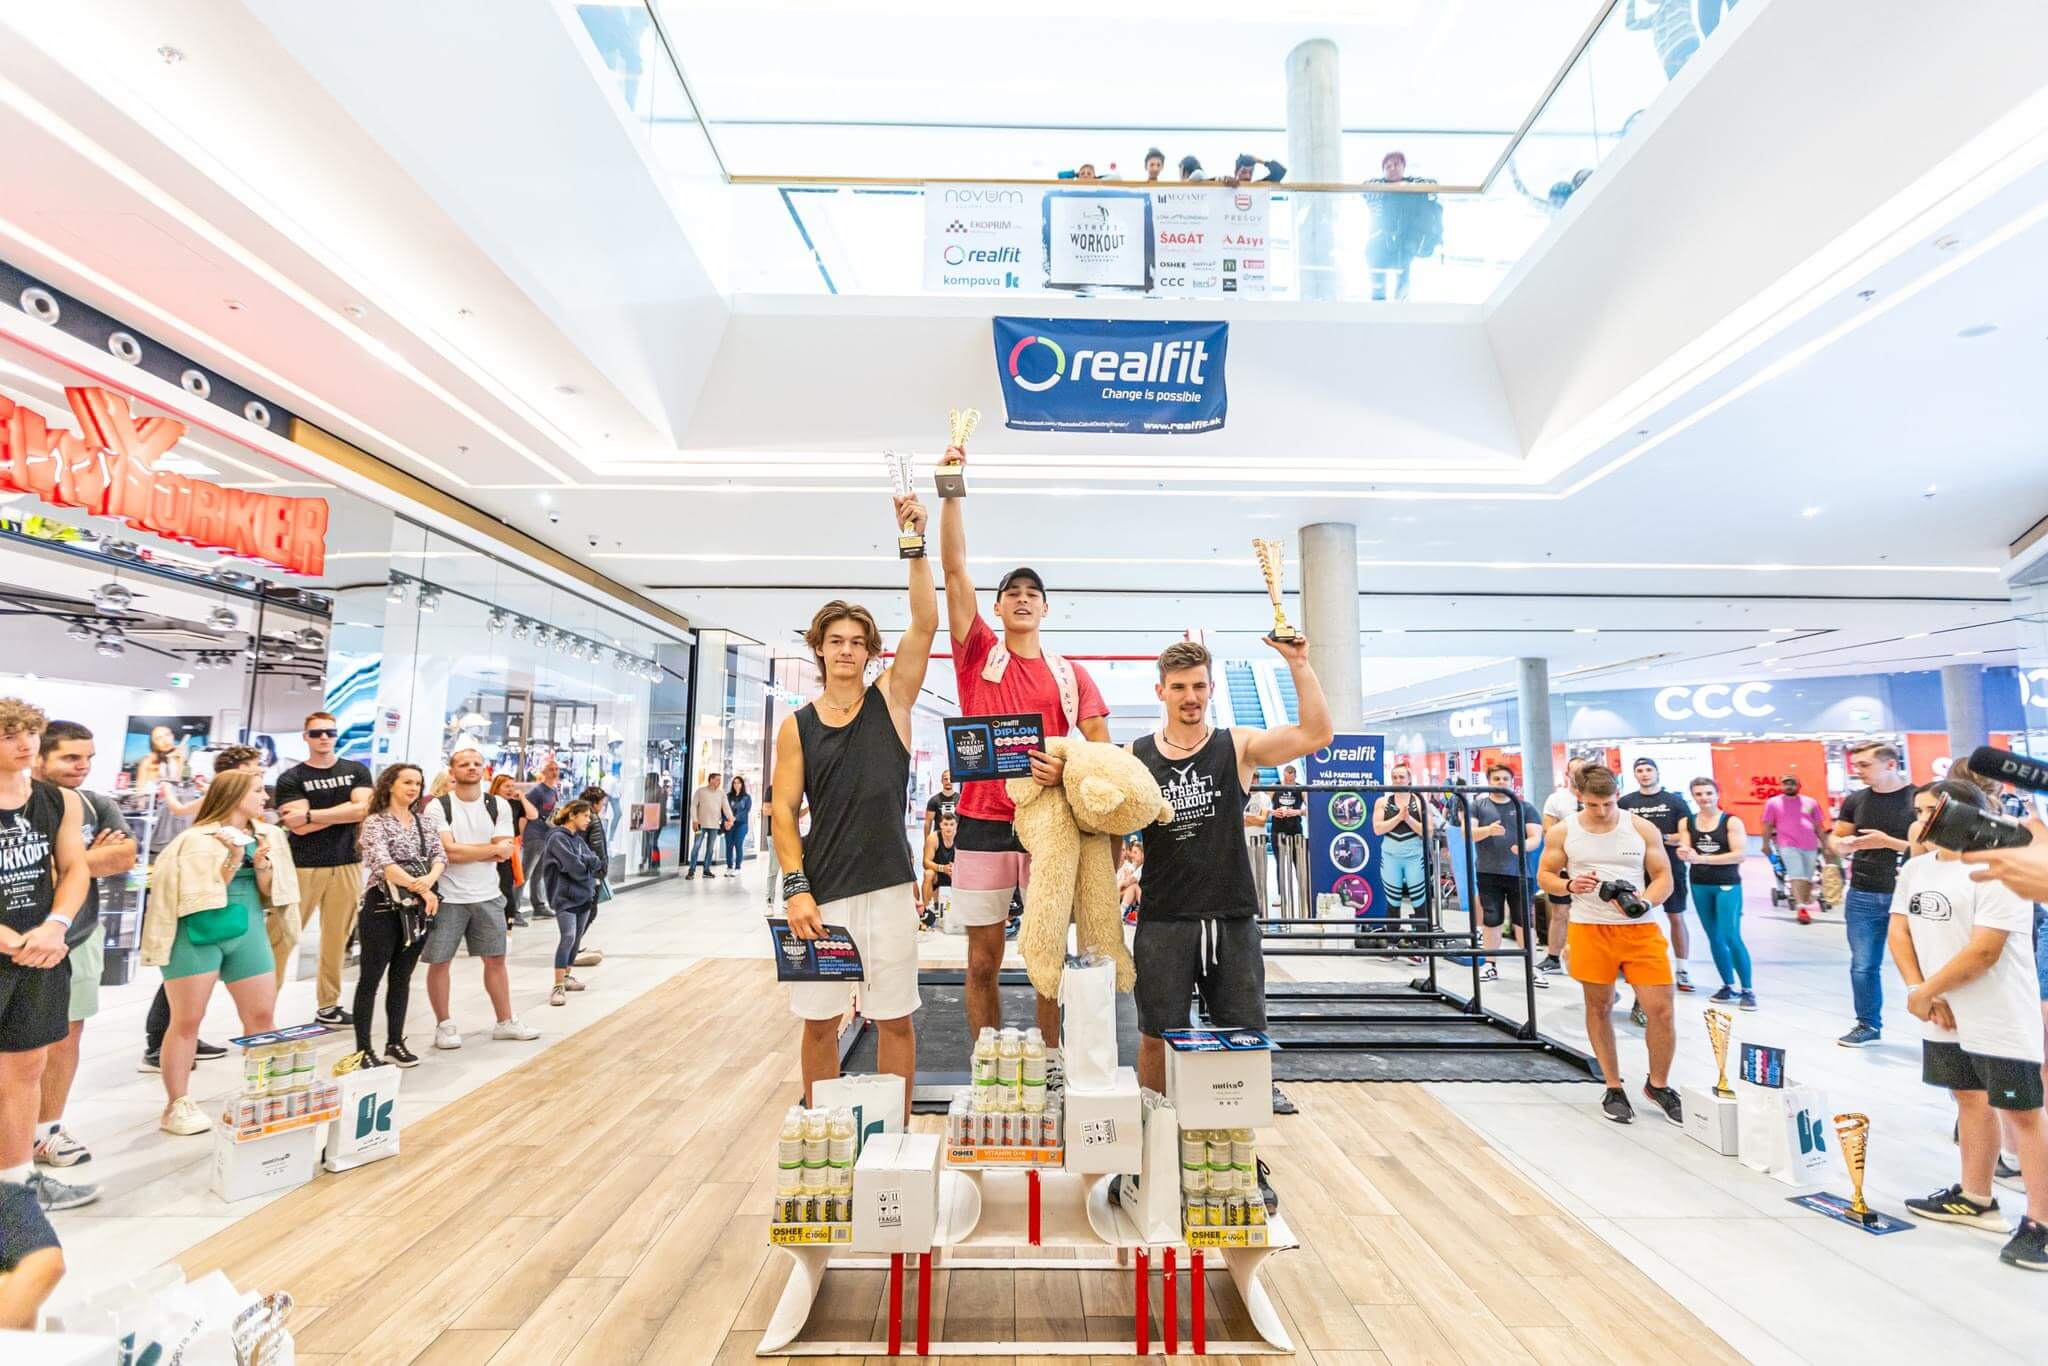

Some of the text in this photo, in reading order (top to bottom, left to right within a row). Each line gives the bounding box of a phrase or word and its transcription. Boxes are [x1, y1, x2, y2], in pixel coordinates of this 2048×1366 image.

[1070, 233, 1126, 252] WORKOUT
[968, 246, 1022, 263] realfit
[944, 275, 1001, 287] kompava
[1160, 278, 1185, 286] CCC
[1070, 341, 1209, 385] realfit
[1102, 387, 1201, 403] Change is possible
[1653, 681, 1776, 720] CCC
[993, 726, 1038, 736] DIPLOM
[1332, 745, 1376, 761] realfit
[2002, 759, 2048, 784] DEIT
[1752, 777, 1780, 785] SAL
[1163, 781, 1206, 800] STREET
[1170, 791, 1213, 811] ORKOUT
[0, 842, 50, 870] RKOUT
[773, 1227, 803, 1236] OSHEE
[1191, 1231, 1220, 1239] OSHEE
